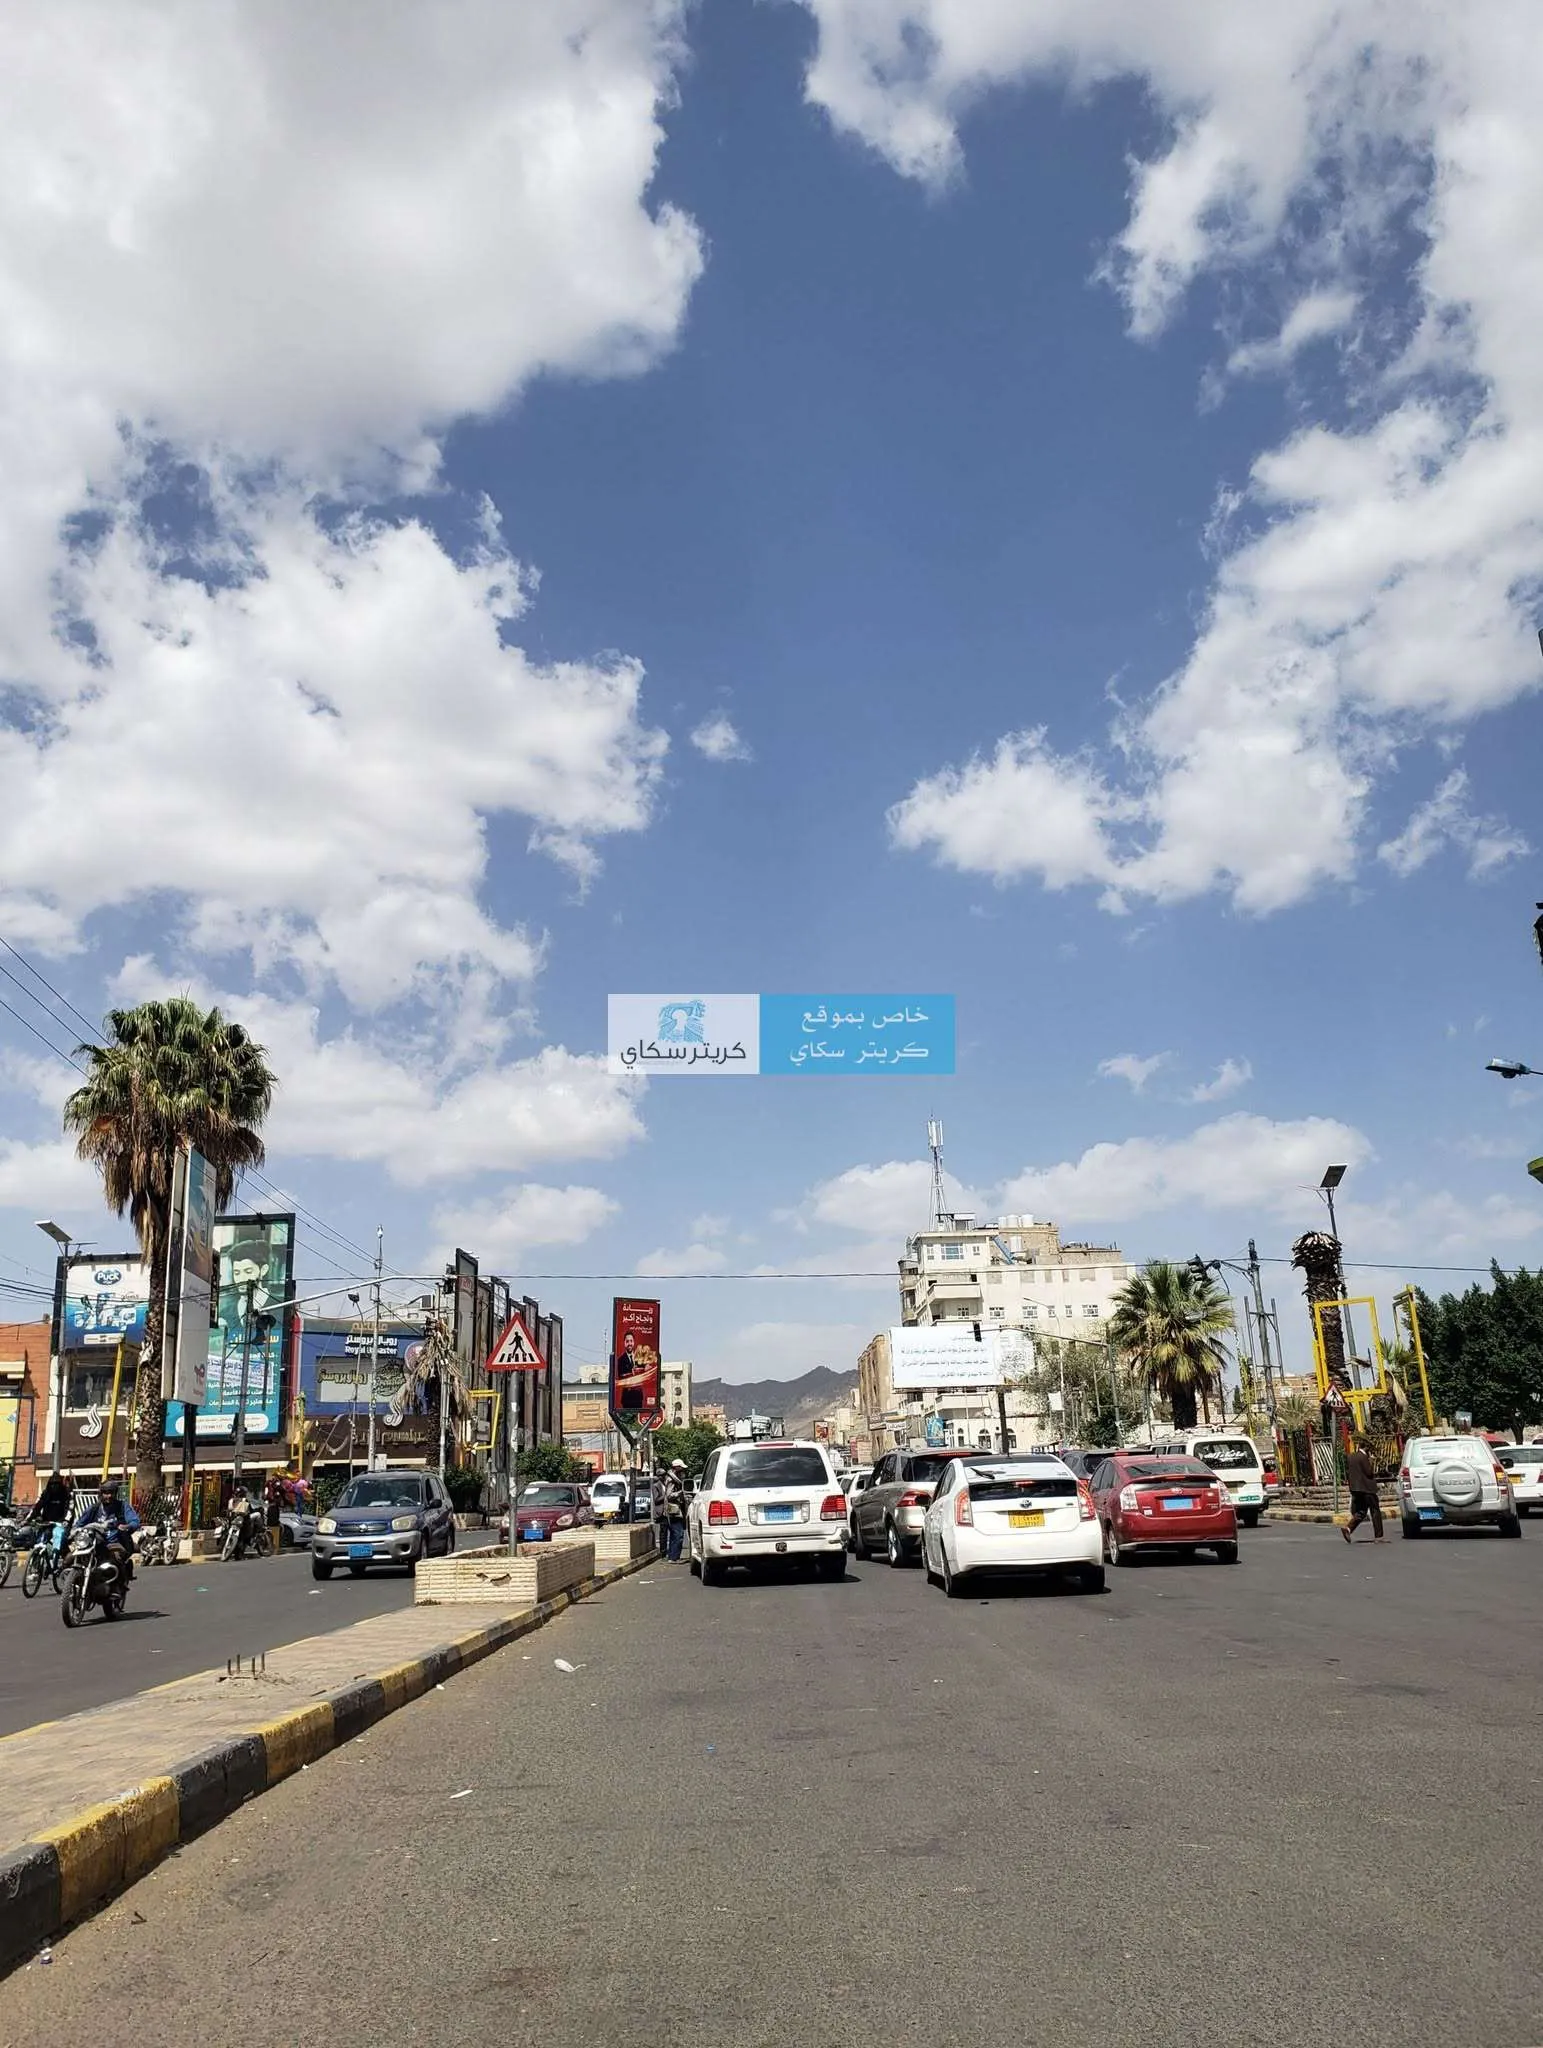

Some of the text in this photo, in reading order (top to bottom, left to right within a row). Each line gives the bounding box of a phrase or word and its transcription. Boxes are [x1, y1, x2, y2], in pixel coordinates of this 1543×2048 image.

[97, 1272, 120, 1281] Puck
[346, 1335, 398, 1347] رويال بروستر
[345, 1346, 366, 1355] Royal
[641, 1416, 662, 1424] SP
[1439, 1478, 1475, 1486] SUZUKI
